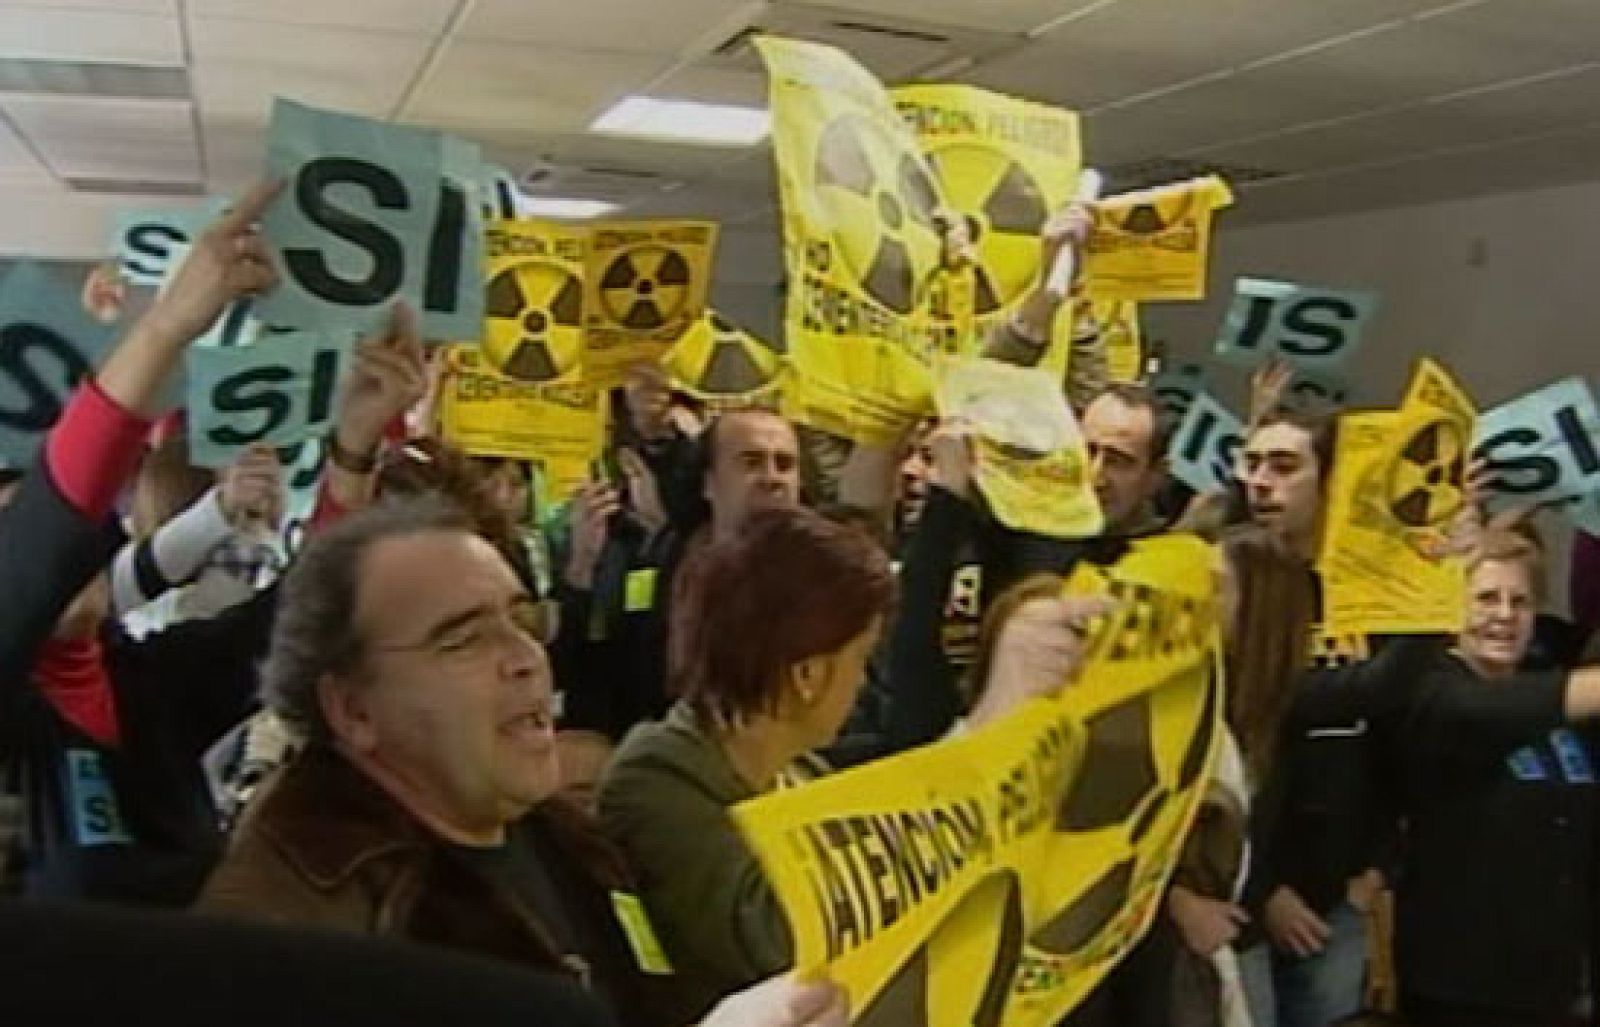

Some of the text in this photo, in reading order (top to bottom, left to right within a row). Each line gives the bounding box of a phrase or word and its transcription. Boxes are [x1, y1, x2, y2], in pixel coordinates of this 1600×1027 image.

[124, 223, 189, 277] S
[281, 157, 467, 314] SI
[0, 323, 90, 432] S
[206, 347, 338, 445] SI
[1472, 405, 1598, 493] SI
